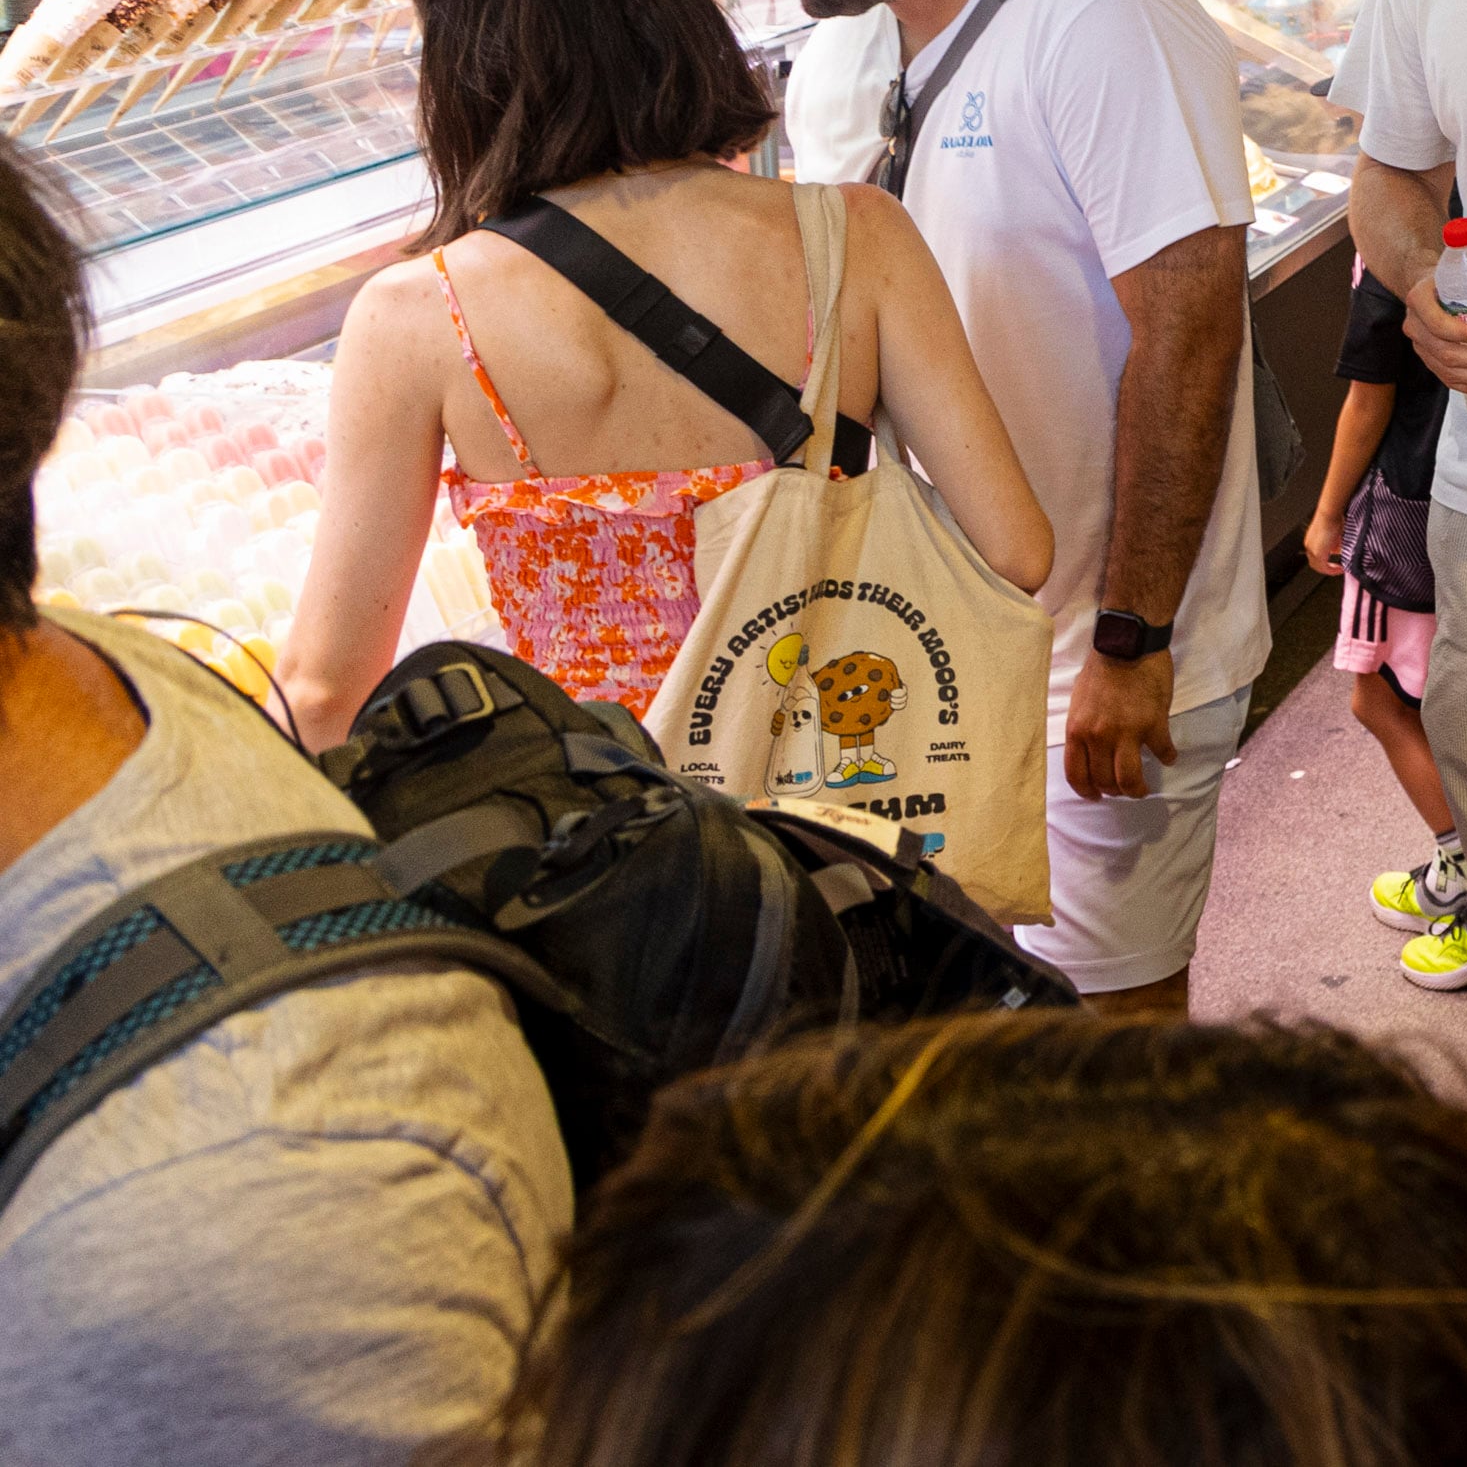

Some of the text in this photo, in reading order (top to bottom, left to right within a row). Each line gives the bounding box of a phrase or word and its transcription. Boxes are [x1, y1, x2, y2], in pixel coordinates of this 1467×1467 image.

[688, 656, 735, 746] EVERY
[727, 588, 808, 658] ARTIST
[857, 582, 926, 632] THEIR
[918, 627, 960, 726] MOOO'S
[929, 741, 966, 751] DAIRY
[925, 752, 971, 764] TREATS
[680, 762, 721, 773] LOCAL
